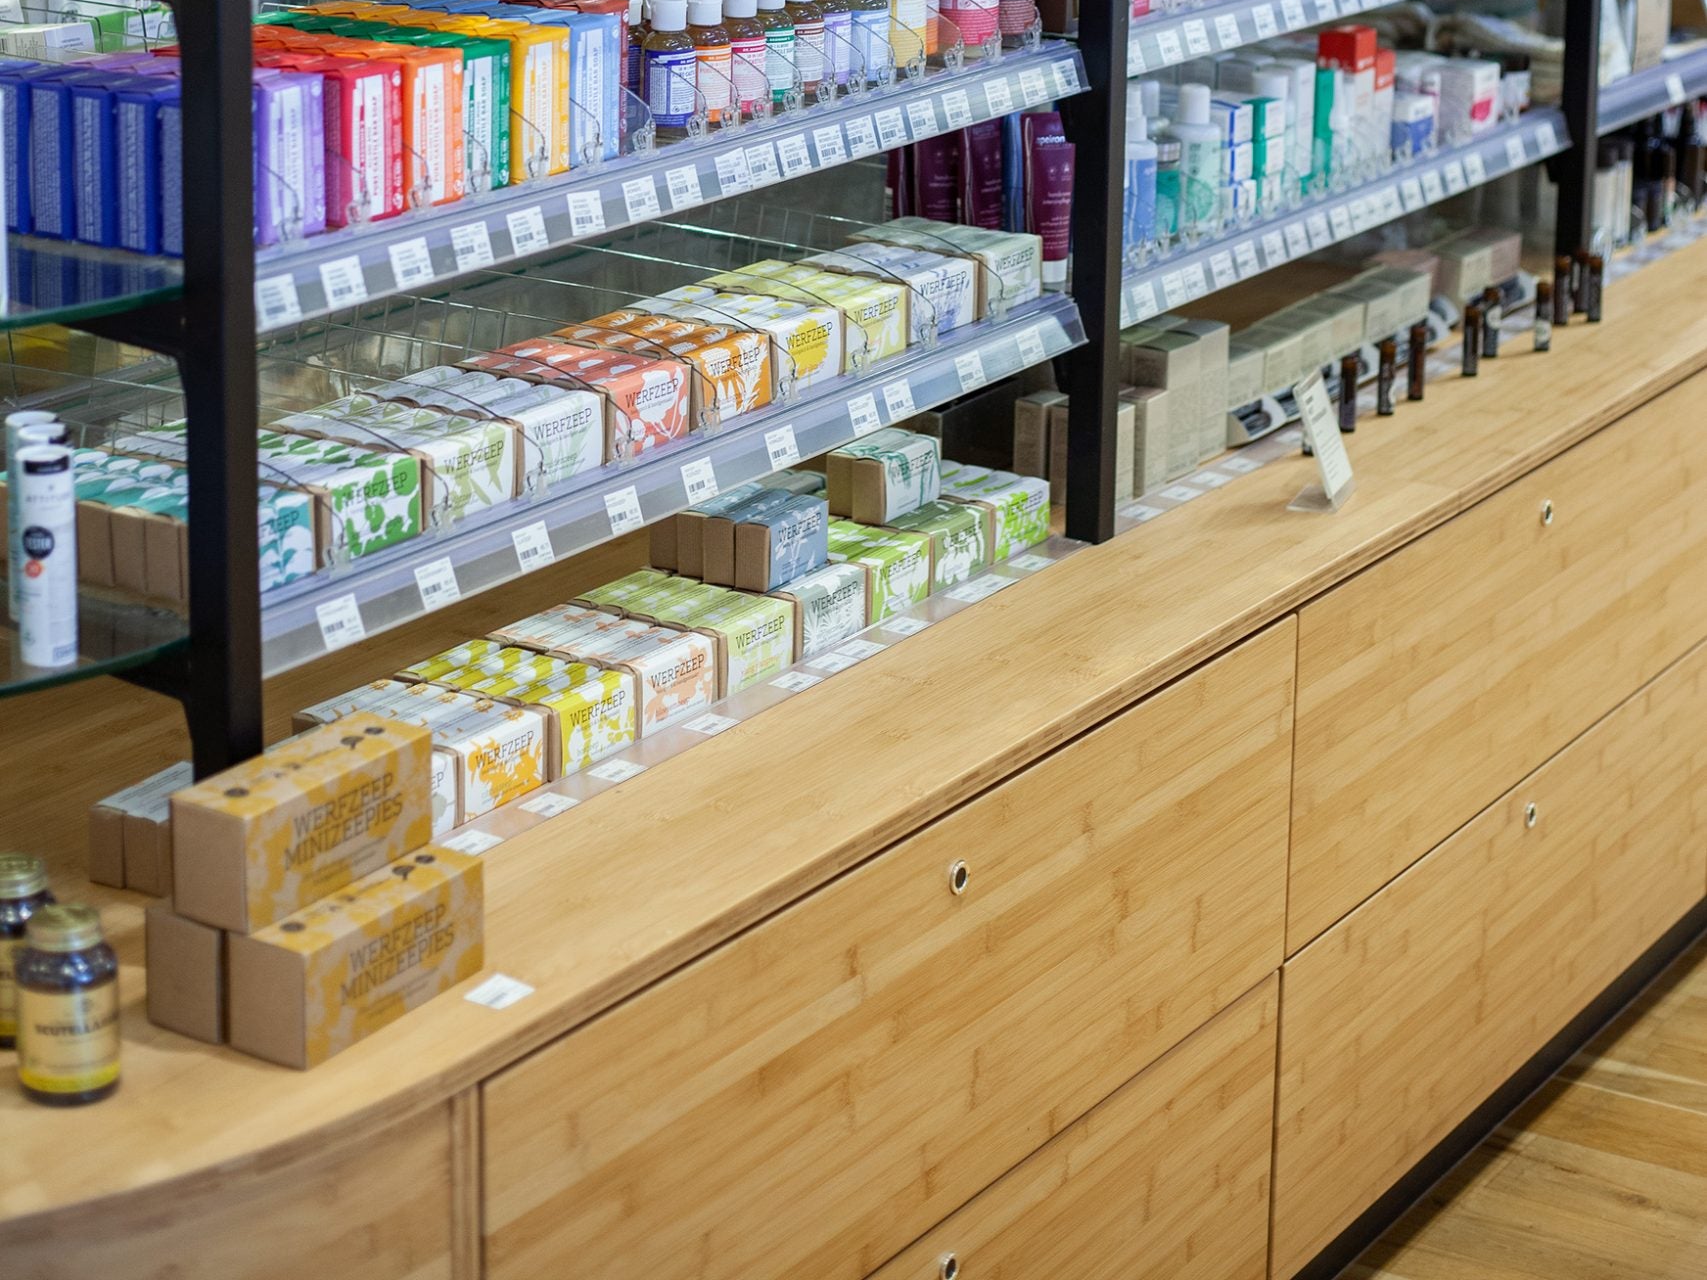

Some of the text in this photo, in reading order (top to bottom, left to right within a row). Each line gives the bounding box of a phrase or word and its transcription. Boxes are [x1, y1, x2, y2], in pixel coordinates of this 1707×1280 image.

[994, 246, 1036, 272] WERFZEEP
[920, 270, 967, 298] WERFZEEP
[854, 296, 899, 324] WERFZEEP
[786, 322, 834, 351] WERFZEEP
[710, 347, 760, 377] WERFZEEP
[625, 377, 680, 409] WERFZEEP
[533, 407, 593, 442] WERFZEEP
[443, 439, 505, 476] WERFZEEP
[342, 471, 413, 506] WERFZEEP
[777, 511, 822, 544] WERFZEEP
[880, 549, 922, 583] WERFZEEP
[810, 580, 859, 615] WERFZEEP
[735, 614, 791, 651] WERFZEEP
[650, 653, 705, 690] WERFZEEP
[569, 689, 626, 728] WERFZEEP
[475, 729, 535, 769] WERFZEEP
[293, 772, 395, 838] WERFZEEP
[284, 791, 404, 871] MINIZEEPJES
[349, 903, 447, 973] WERFZEEP
[339, 924, 456, 1008] MINIZEEPJES
